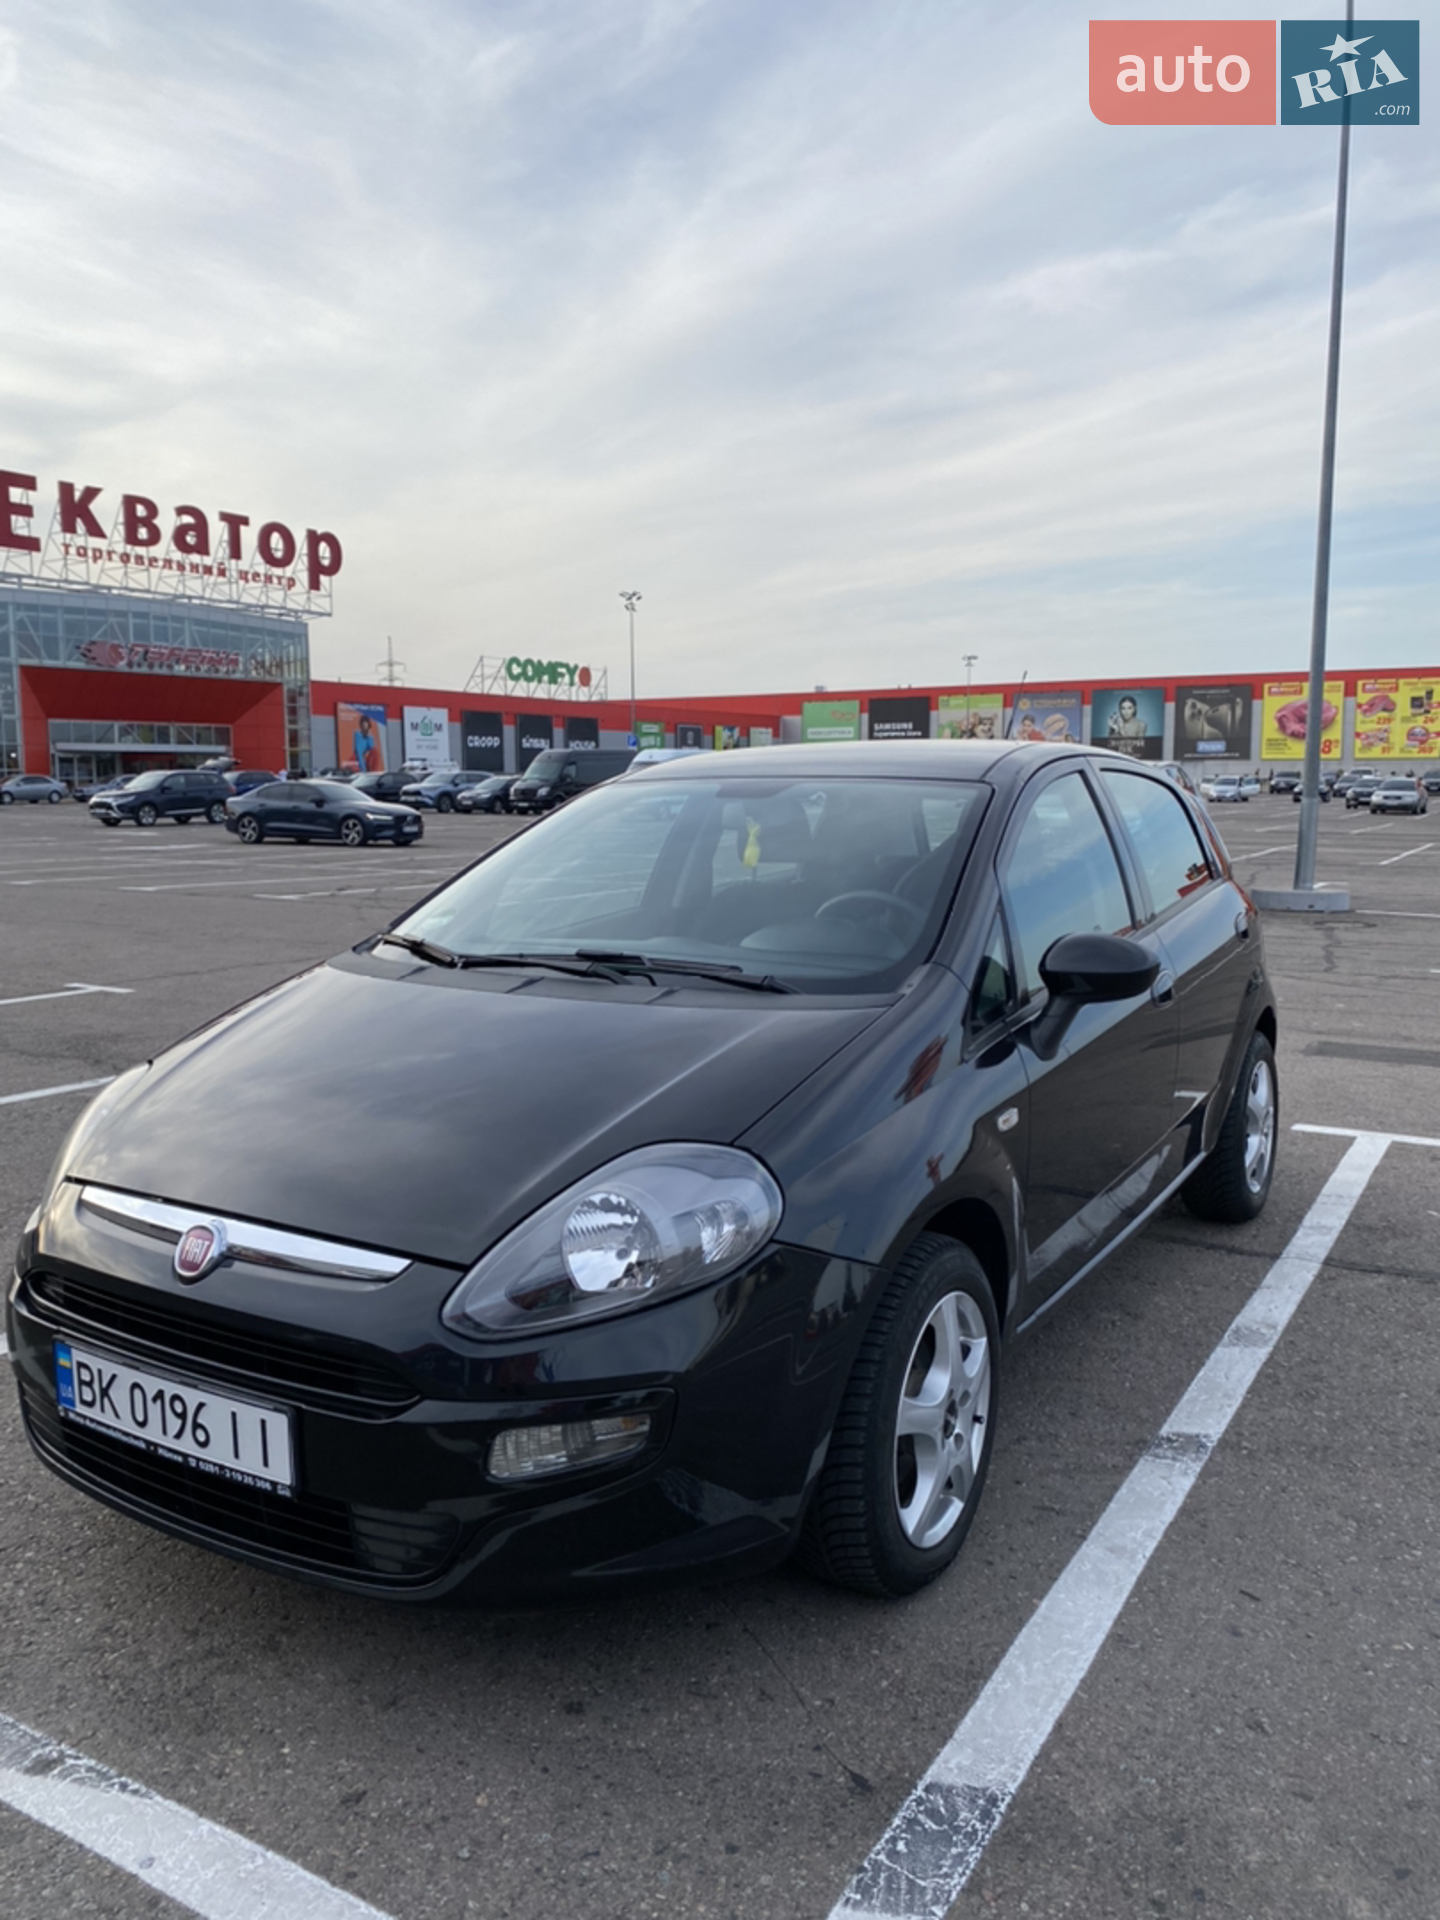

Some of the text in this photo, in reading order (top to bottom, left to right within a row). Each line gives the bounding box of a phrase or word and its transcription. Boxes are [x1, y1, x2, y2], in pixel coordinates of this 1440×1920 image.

[62, 542, 297, 591] торговельний центр
[505, 656, 579, 687] COMFY
[873, 721, 913, 731] SAMSUNG
[466, 735, 500, 748] CROPP
[181, 1237, 211, 1265] FIAT
[75, 1360, 121, 1421] BK
[129, 1381, 211, 1450] 0196
